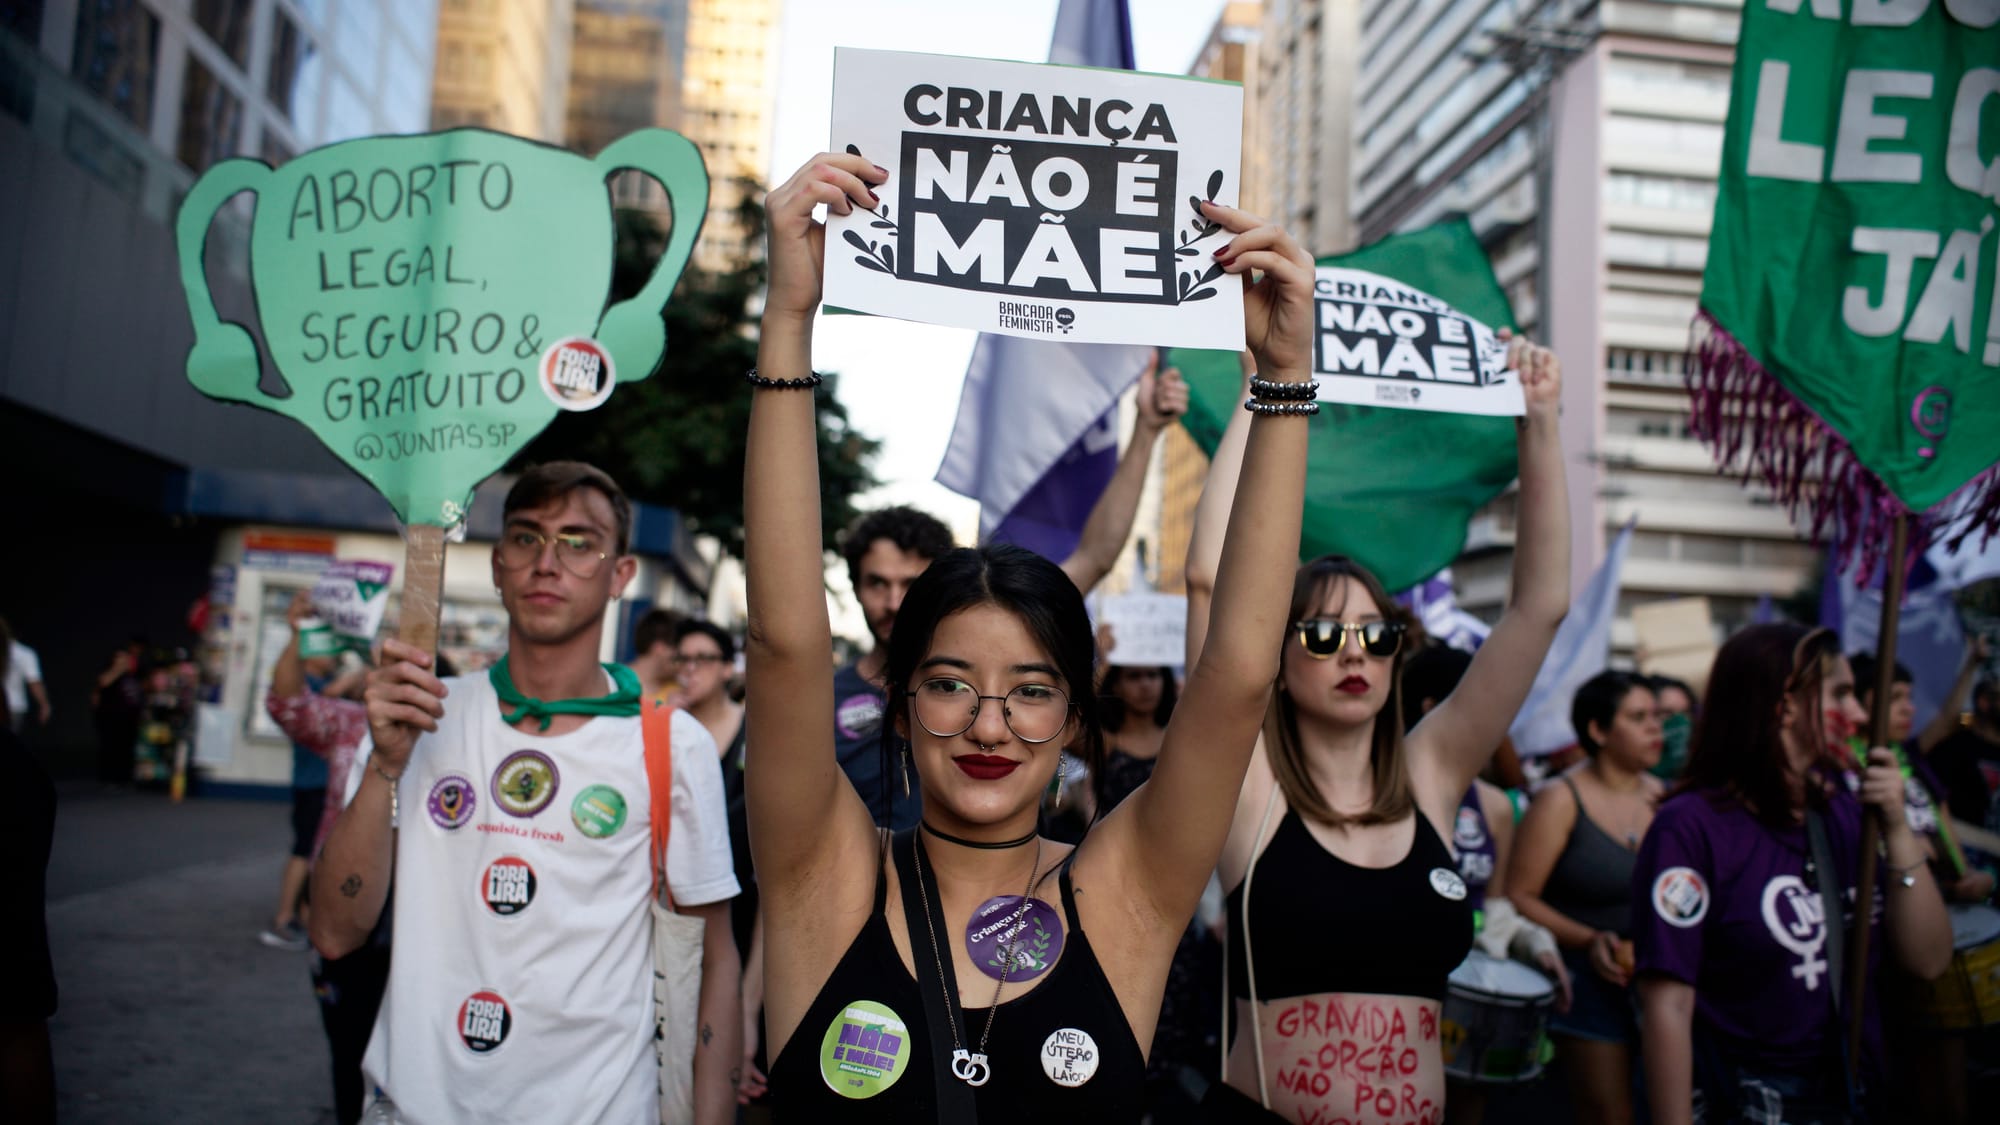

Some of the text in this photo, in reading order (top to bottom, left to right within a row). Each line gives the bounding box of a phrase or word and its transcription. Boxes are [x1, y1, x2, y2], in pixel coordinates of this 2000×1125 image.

[903, 84, 1177, 147] CRIANÇA
[915, 144, 1160, 217] NÃO É
[288, 160, 513, 240] ABORTO
[319, 245, 488, 291] LEGAL,
[913, 211, 1164, 297] MÃE
[1000, 301, 1053, 320] BANCADA
[1000, 315, 1053, 334] FEMINISTA
[301, 309, 543, 363] SEGURO &
[558, 347, 600, 371] FORA
[1322, 334, 1475, 383] MÃE
[552, 360, 599, 392] LIRA
[323, 368, 525, 423] GRATUITO
[488, 865, 528, 883] FORA
[488, 880, 528, 903] LIRA
[971, 916, 1014, 942] Criança
[466, 1000, 505, 1020] FORA
[463, 1016, 502, 1041] LIRA
[838, 1023, 902, 1056] NÃO
[1056, 1032, 1085, 1046] MEU
[833, 1044, 895, 1072] É MÃE!
[1047, 1041, 1093, 1062] ÚTERO
[1317, 1040, 1418, 1083] OPÇÃO
[1276, 1058, 1331, 1097] NÃO
[1355, 1083, 1417, 1117] POR
